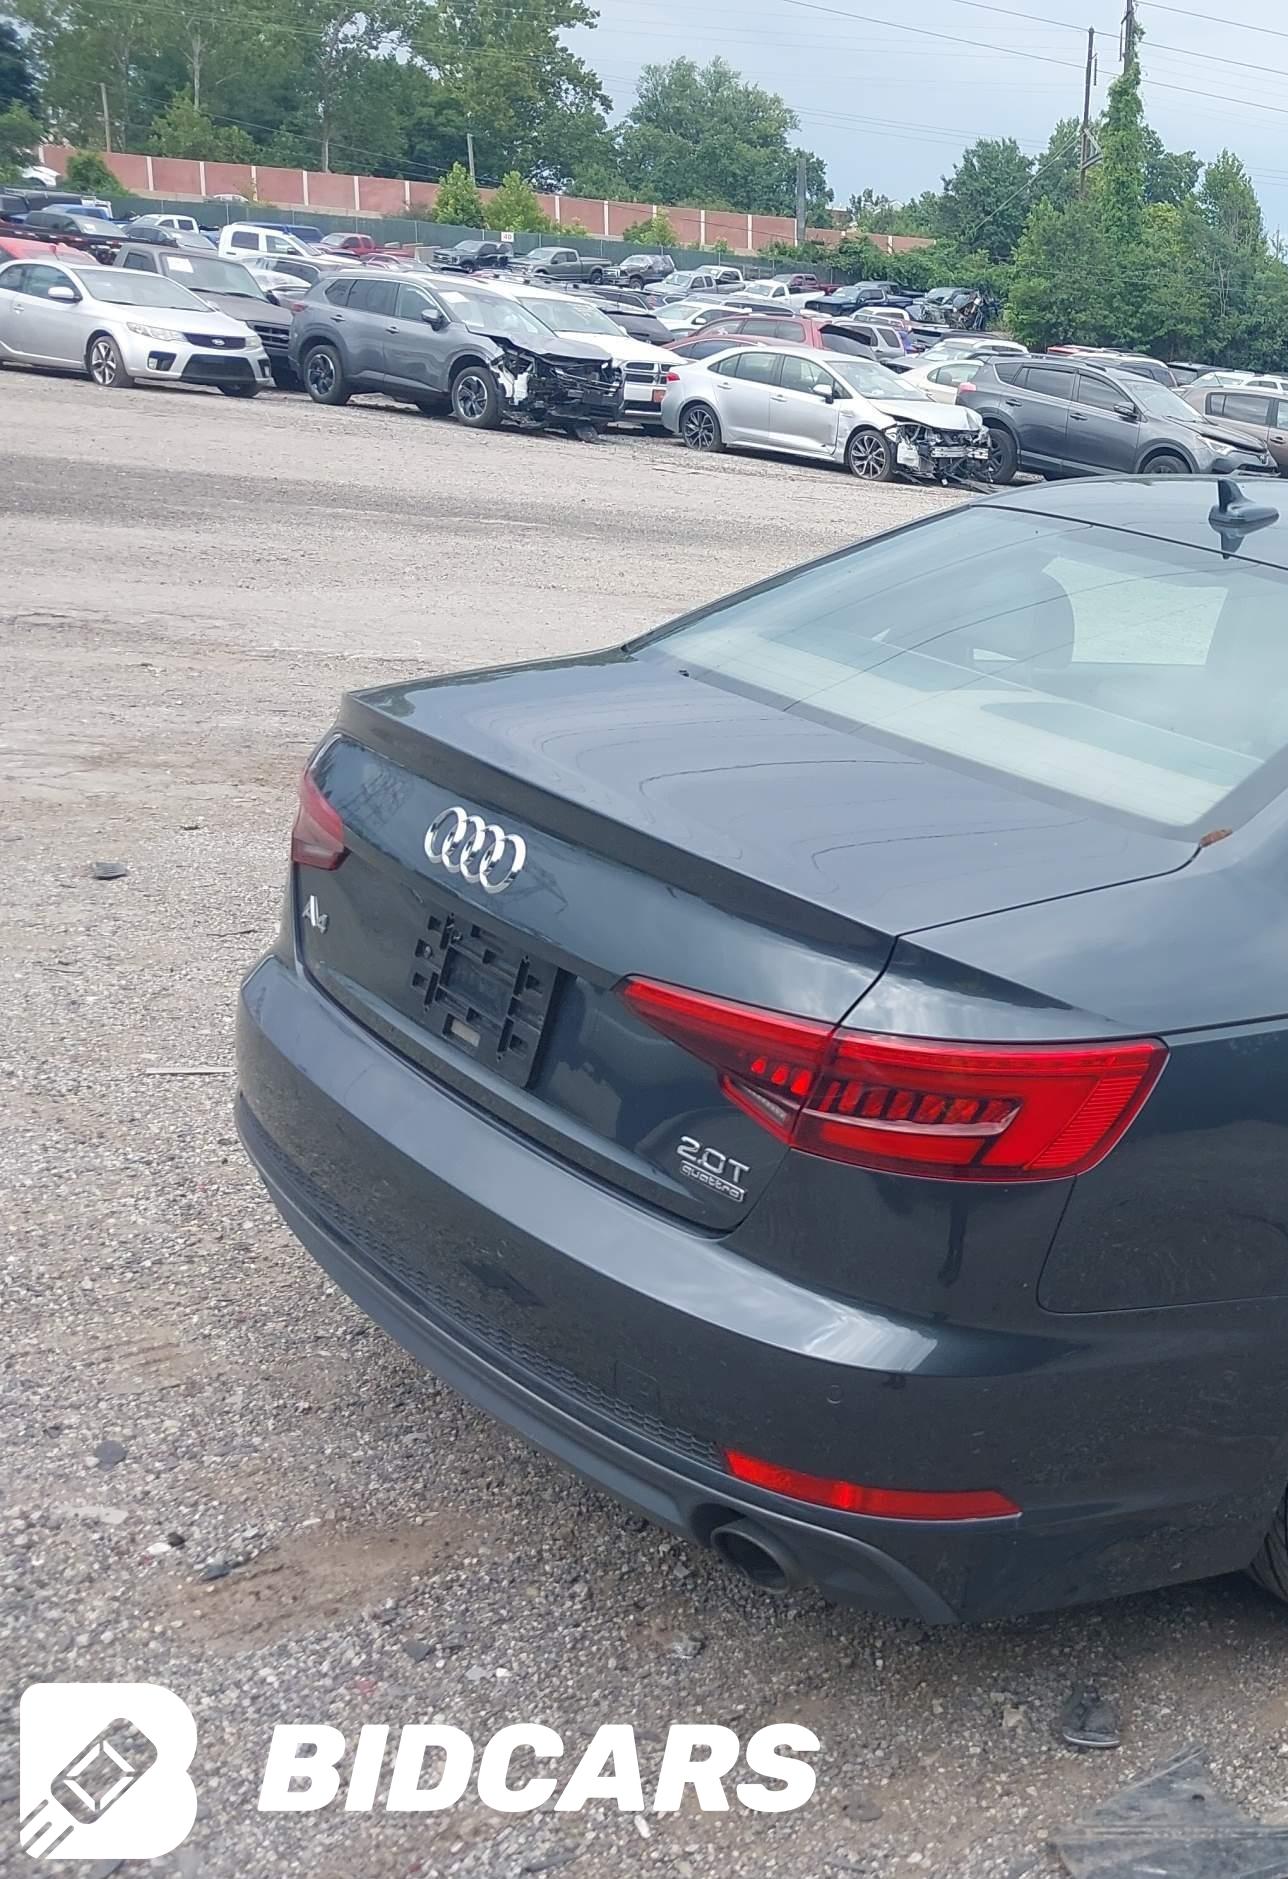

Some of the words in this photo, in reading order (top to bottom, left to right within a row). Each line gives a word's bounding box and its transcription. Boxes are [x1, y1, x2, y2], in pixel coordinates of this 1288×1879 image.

[302, 895, 328, 934] A4
[677, 1136, 750, 1183] 2.0T
[680, 1164, 740, 1198] quattro
